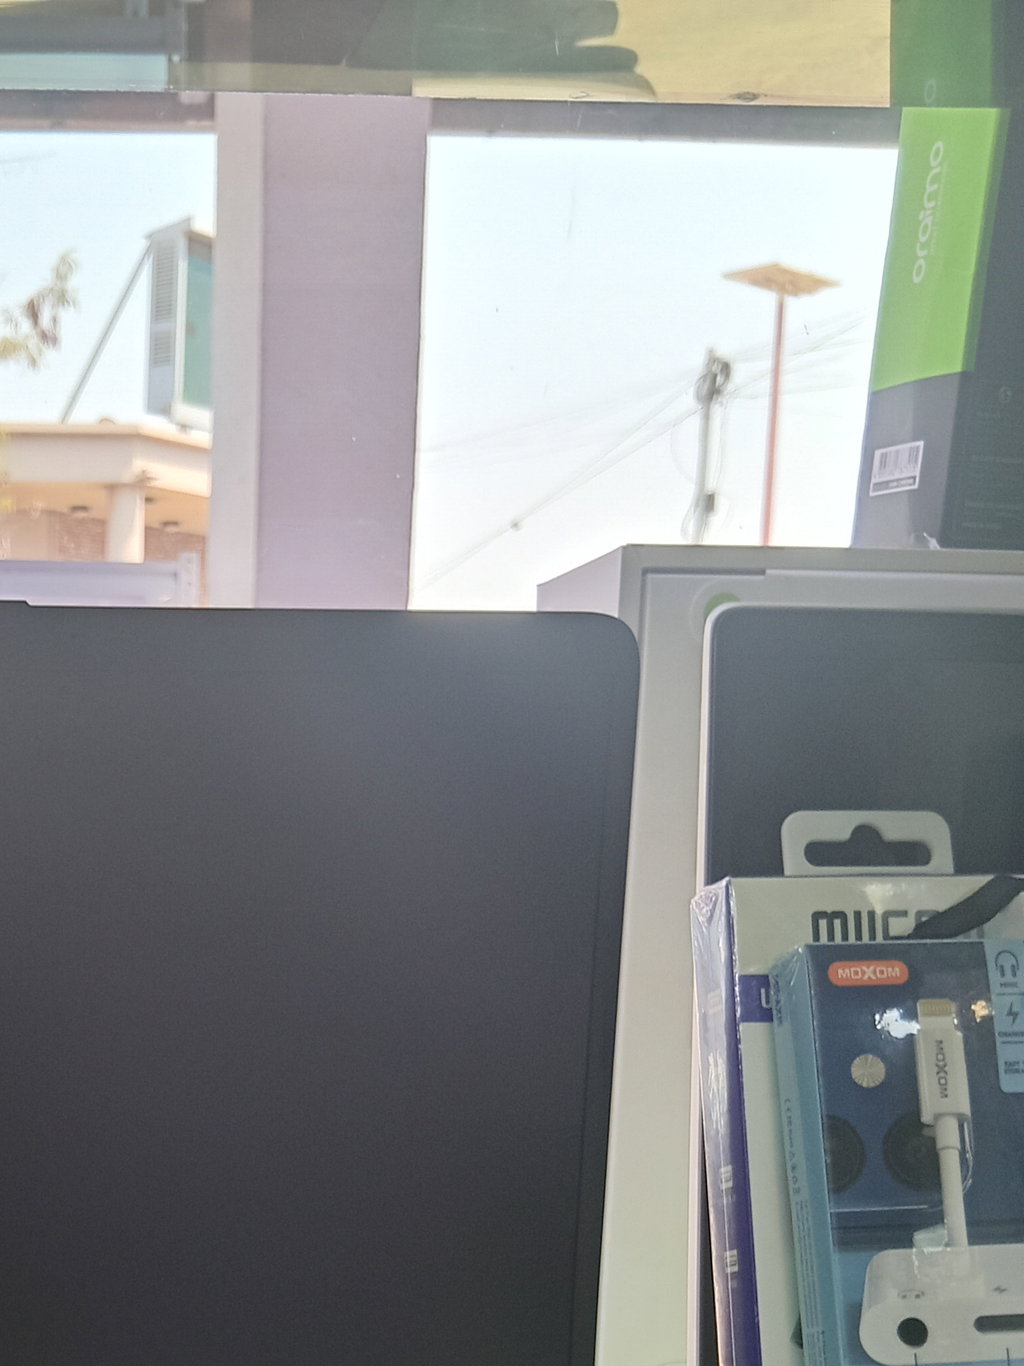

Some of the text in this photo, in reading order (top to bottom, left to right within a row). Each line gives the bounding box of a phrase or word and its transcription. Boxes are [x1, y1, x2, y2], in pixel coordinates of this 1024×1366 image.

[912, 141, 944, 283] oraimo
[837, 965, 901, 980] MOXOM
[934, 1040, 948, 1099] MOXOM
